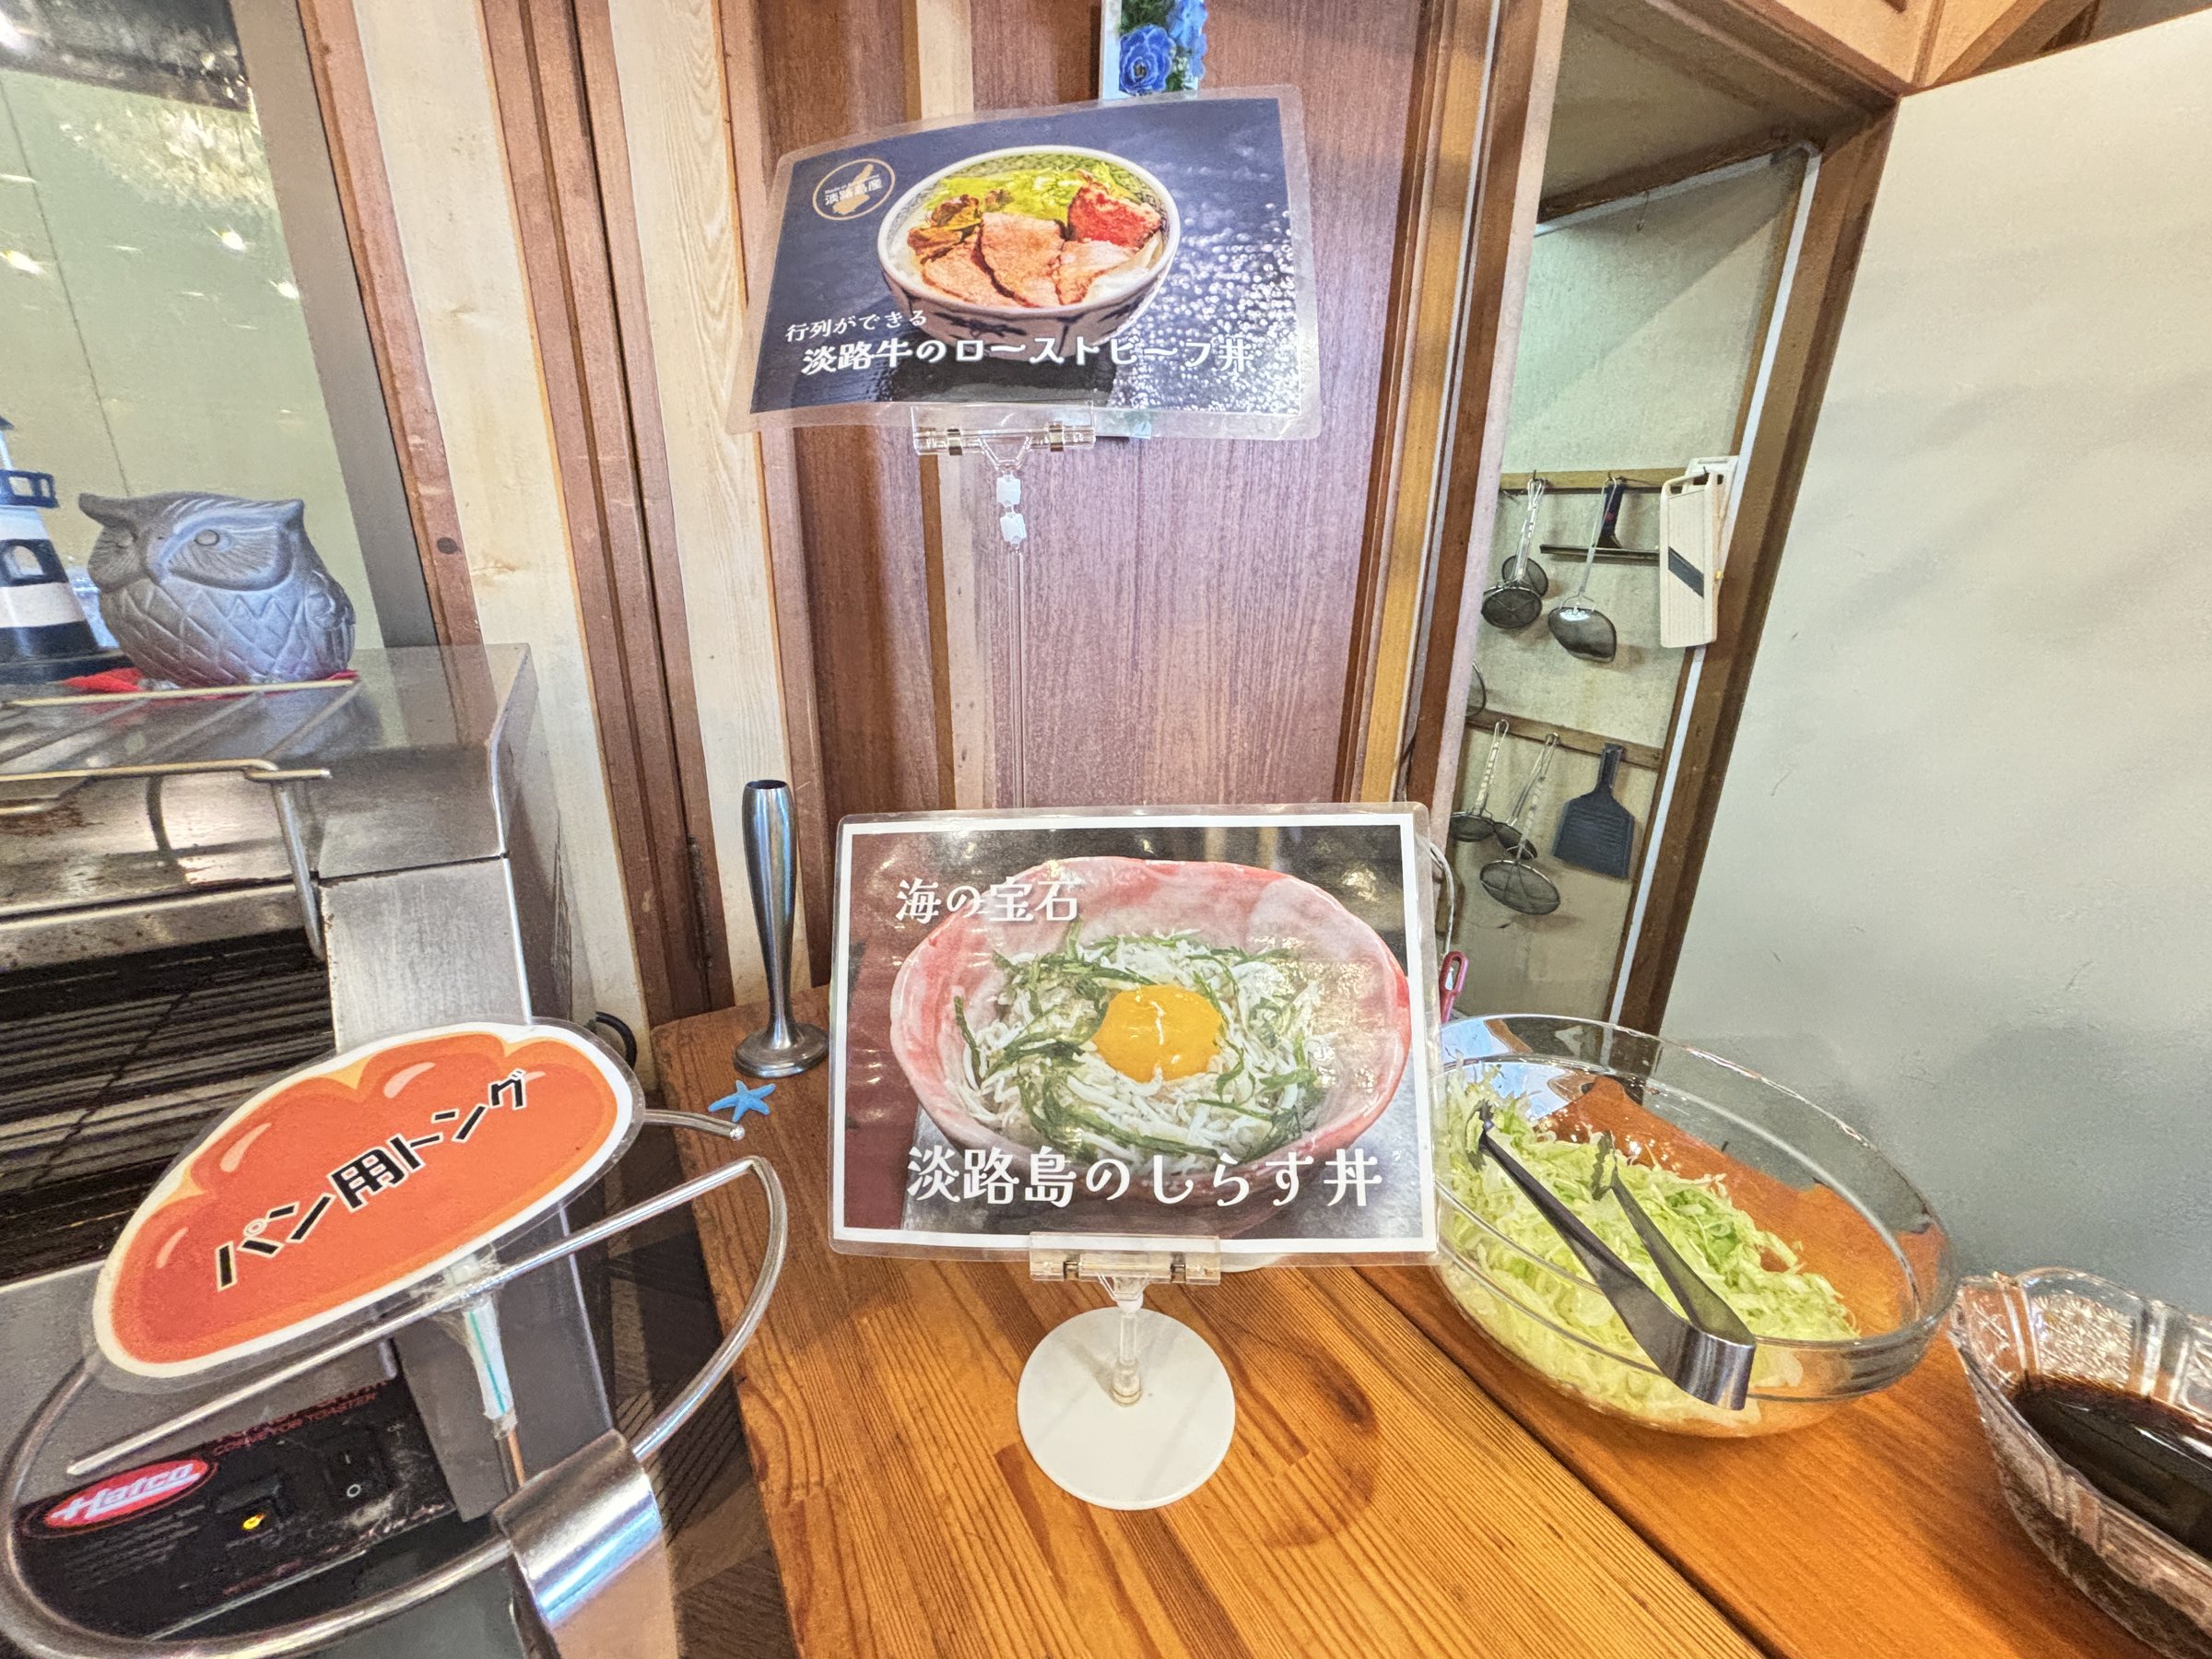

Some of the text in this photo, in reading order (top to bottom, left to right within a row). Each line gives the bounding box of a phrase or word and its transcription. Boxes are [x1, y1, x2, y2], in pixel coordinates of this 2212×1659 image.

[785, 310, 927, 342] 行列ができる
[801, 334, 1255, 376] 淡路牛のローストビーフ丼
[895, 877, 1084, 924] 海の宝石
[216, 1068, 527, 1291] パン用トング
[907, 1145, 1382, 1208] 淡路島のしらす丼
[51, 1463, 202, 1521] Hatco
